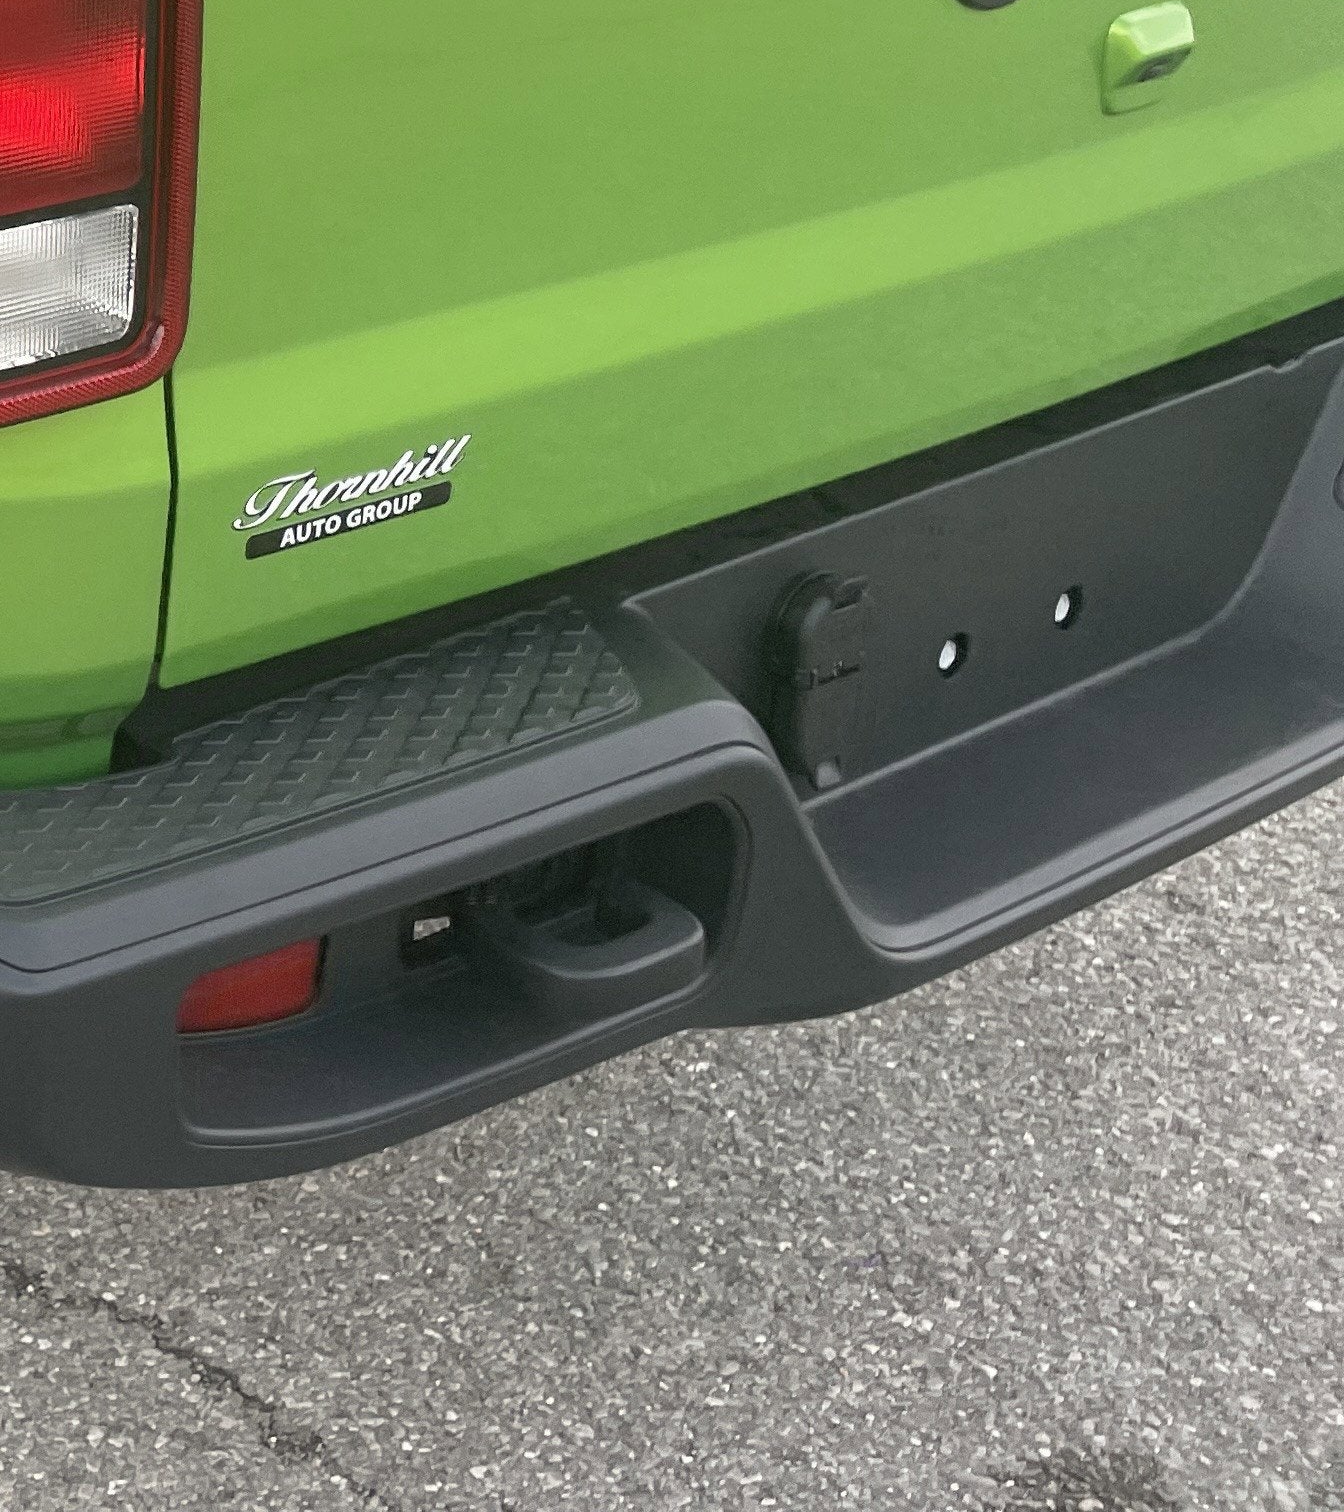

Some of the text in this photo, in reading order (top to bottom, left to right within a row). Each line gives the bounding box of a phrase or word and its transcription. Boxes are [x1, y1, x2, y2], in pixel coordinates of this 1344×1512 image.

[232, 434, 472, 530] Thornhill
[280, 491, 423, 549] AUTO GROUP
